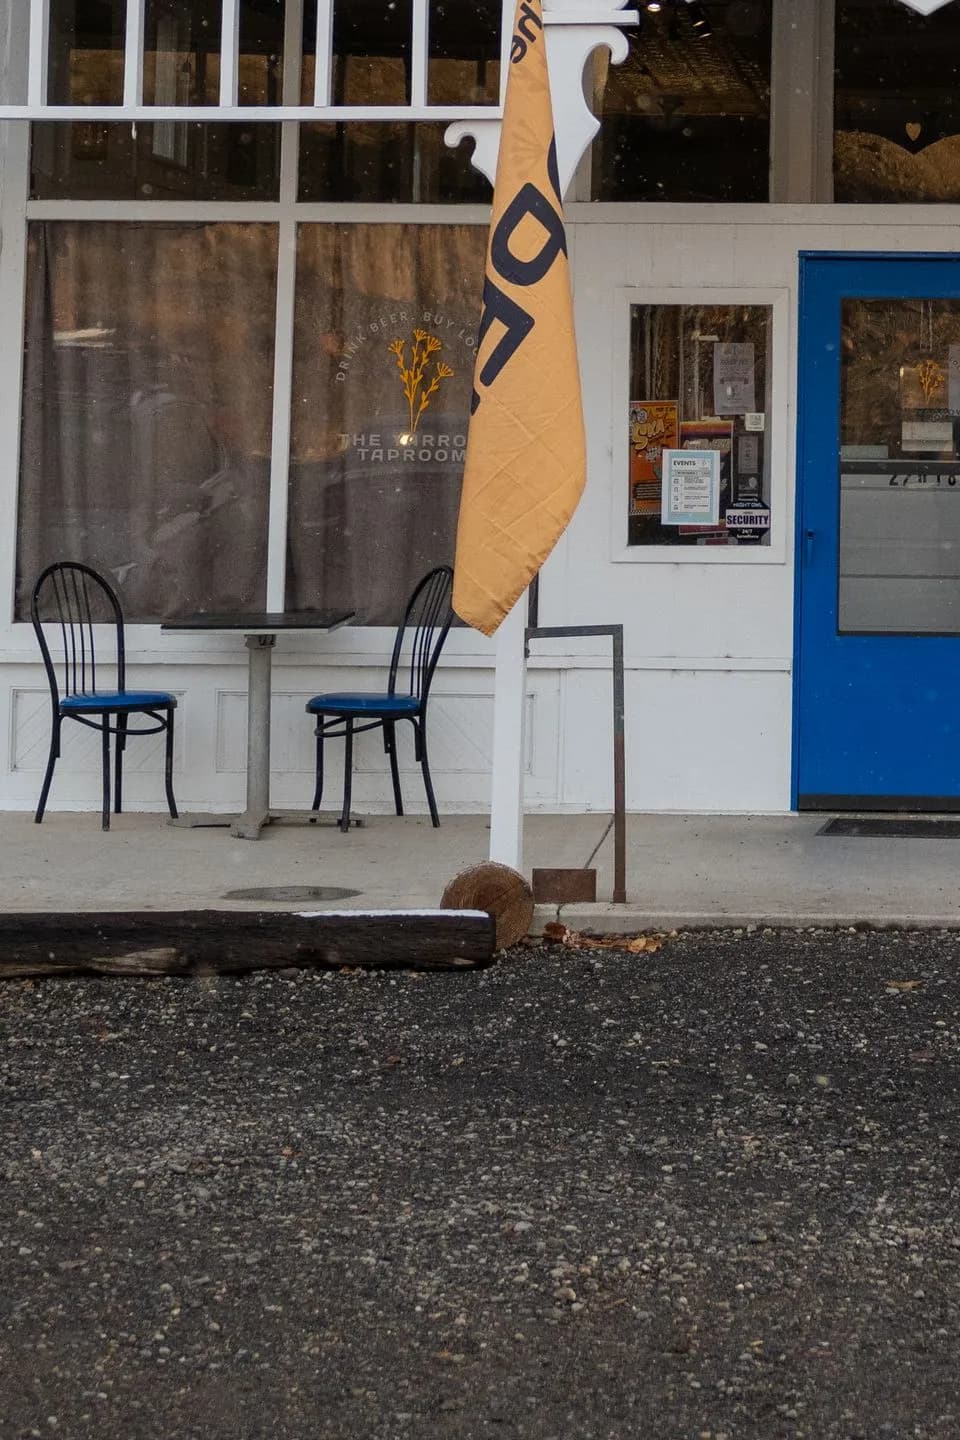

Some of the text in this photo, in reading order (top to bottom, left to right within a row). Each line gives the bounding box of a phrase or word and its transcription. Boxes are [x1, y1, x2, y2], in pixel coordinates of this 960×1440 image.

[336, 333, 367, 382] DRINK
[423, 311, 455, 329] BUY
[458, 329, 478, 357] LOC
[336, 433, 466, 447] THE ARRO
[357, 448, 466, 462] TAPROOM
[726, 514, 769, 525] SECURITY
